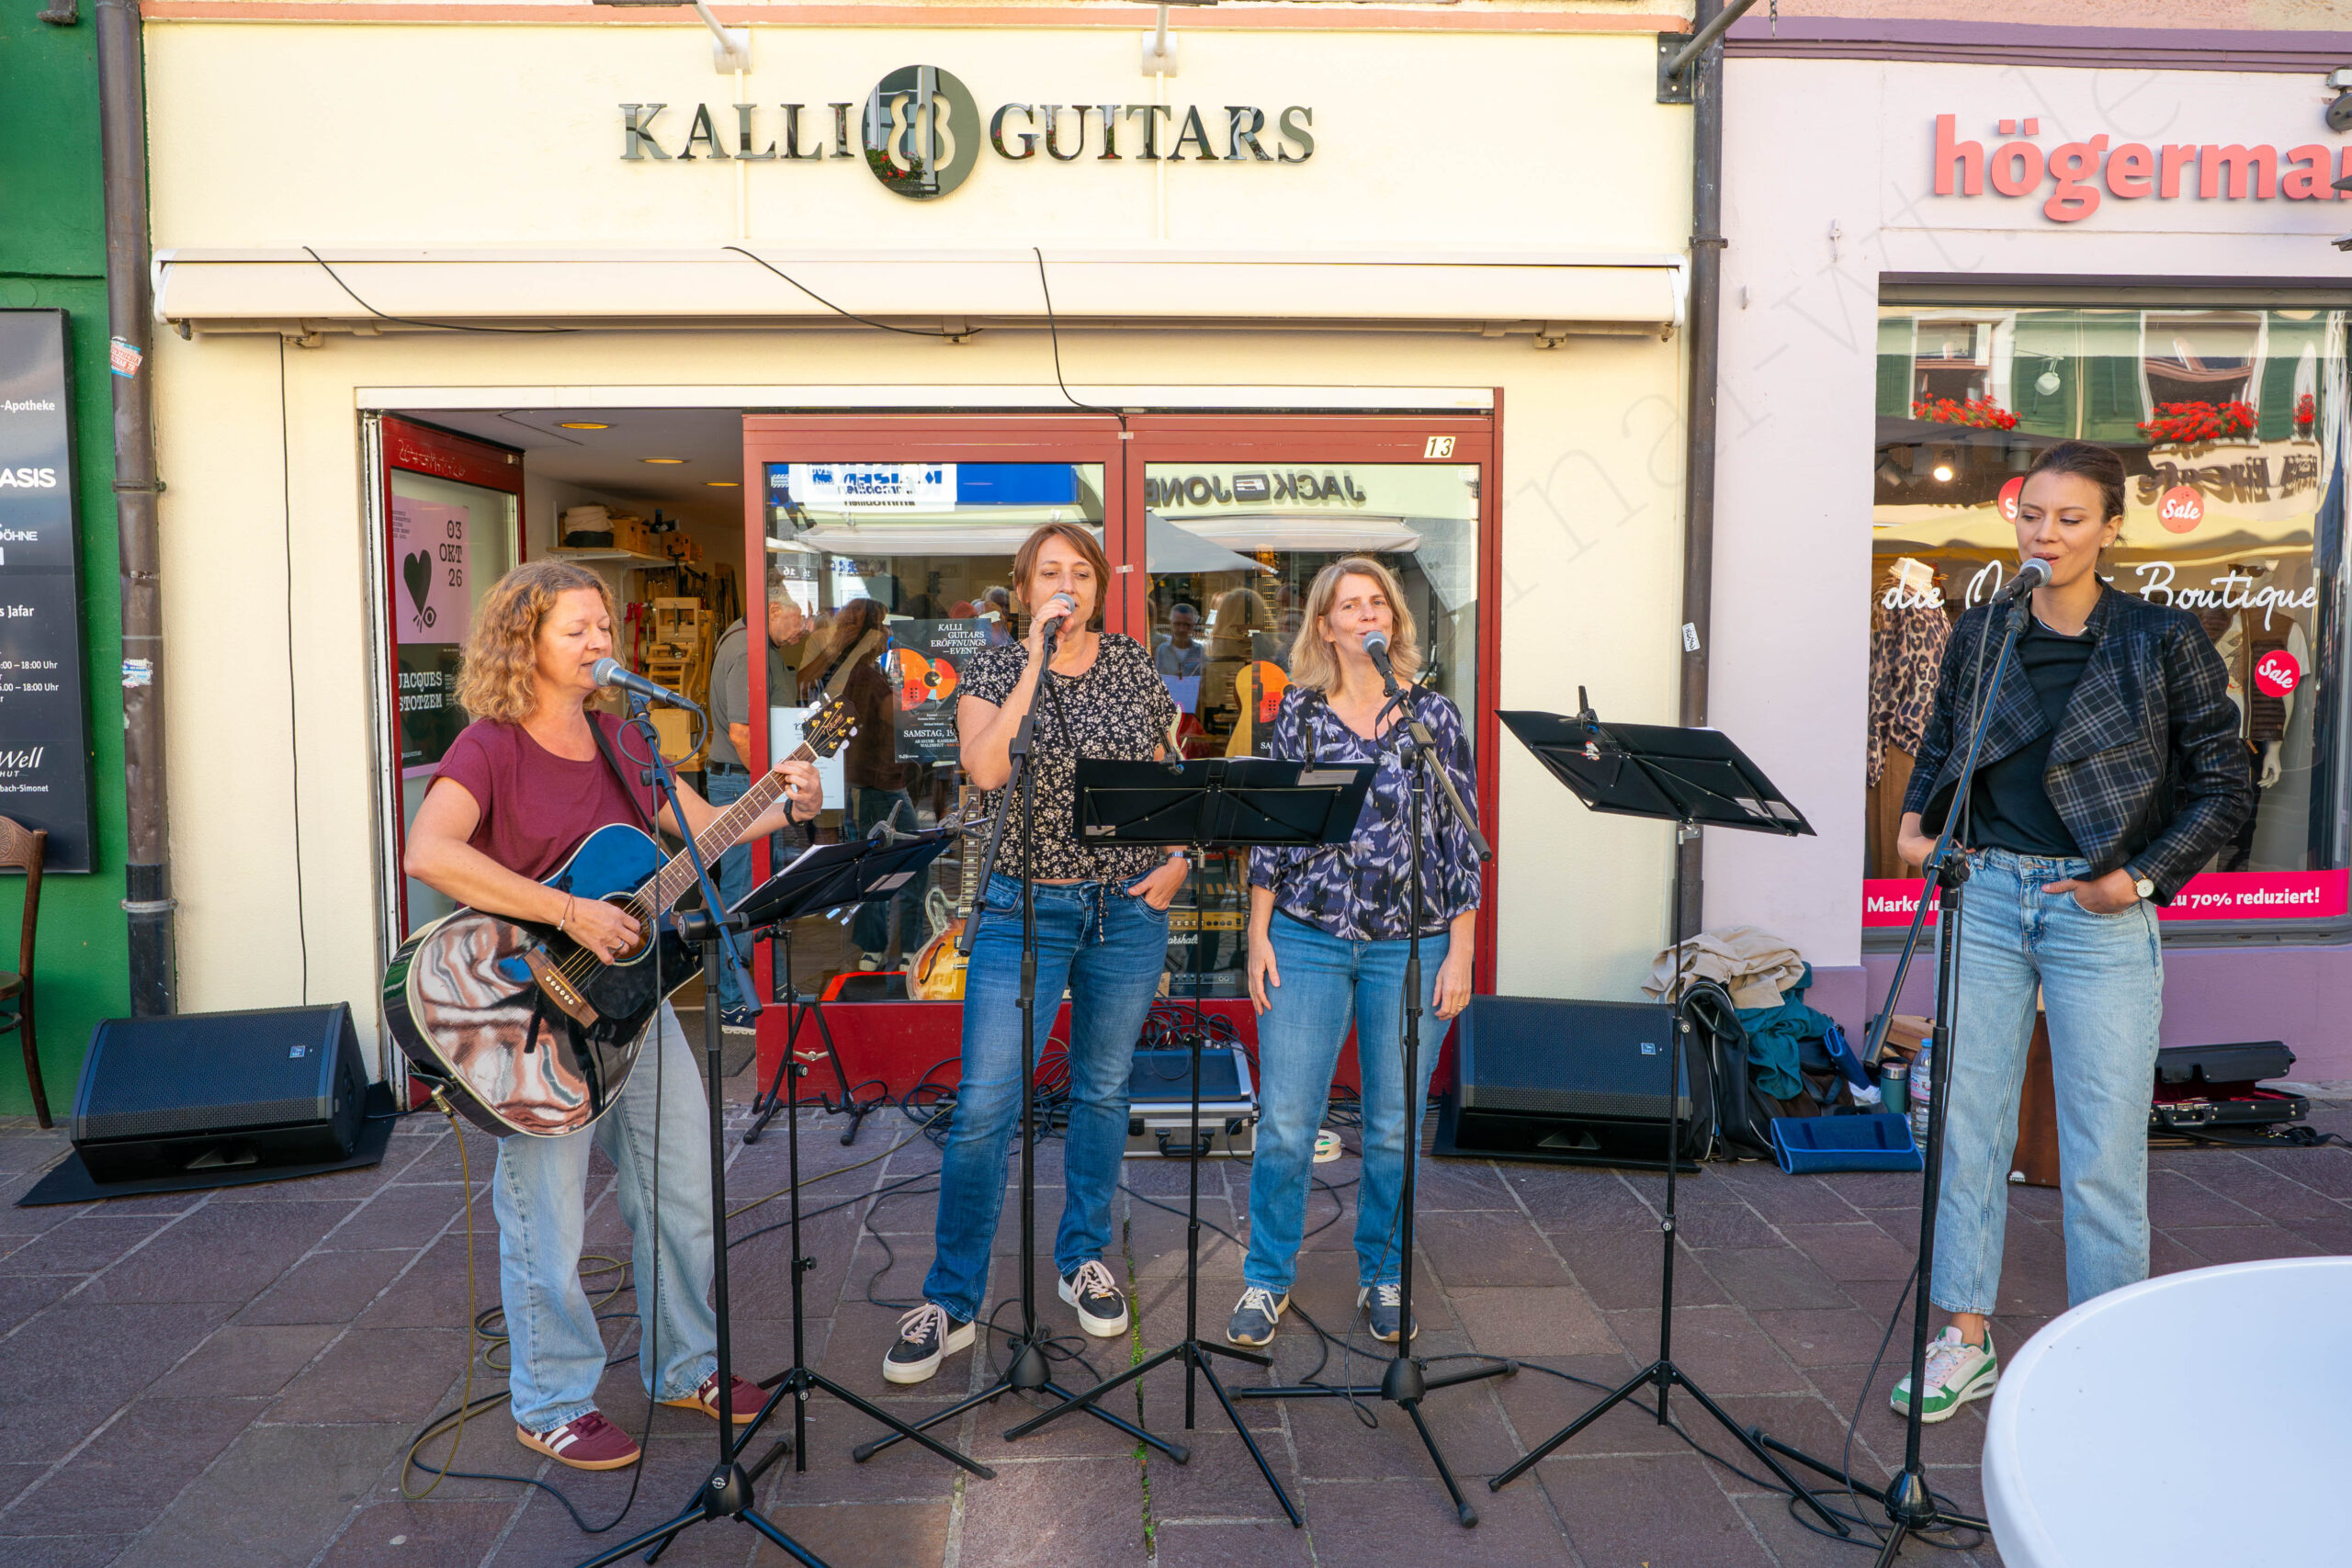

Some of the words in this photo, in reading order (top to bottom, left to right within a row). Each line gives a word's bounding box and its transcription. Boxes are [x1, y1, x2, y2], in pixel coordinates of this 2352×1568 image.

[618, 102, 856, 161] KALLI
[989, 102, 1315, 163] GUITARS
[1430, 437, 1453, 457] 13
[2162, 499, 2200, 520] Sale
[447, 520, 462, 539] 03
[439, 543, 462, 563] OKT
[448, 569, 462, 587] 26
[1882, 560, 1945, 610] die
[2135, 560, 2318, 631] Boutique
[7, 605, 34, 618] Jafar
[931, 638, 986, 647] ERÖFFNUNGS
[21, 660, 41, 670] 18:00
[43, 660, 58, 670] Uhr
[2258, 659, 2293, 689] Sale
[23, 682, 42, 692] 18:00
[44, 682, 59, 692] Uhr
[398, 671, 443, 693] JACQUES
[399, 694, 443, 712] STOTZEM
[903, 729, 944, 739] SAMSTAG,
[2191, 893, 2233, 908] 70%
[2236, 886, 2321, 906] reduziert!
[1168, 931, 1198, 945] arshall
